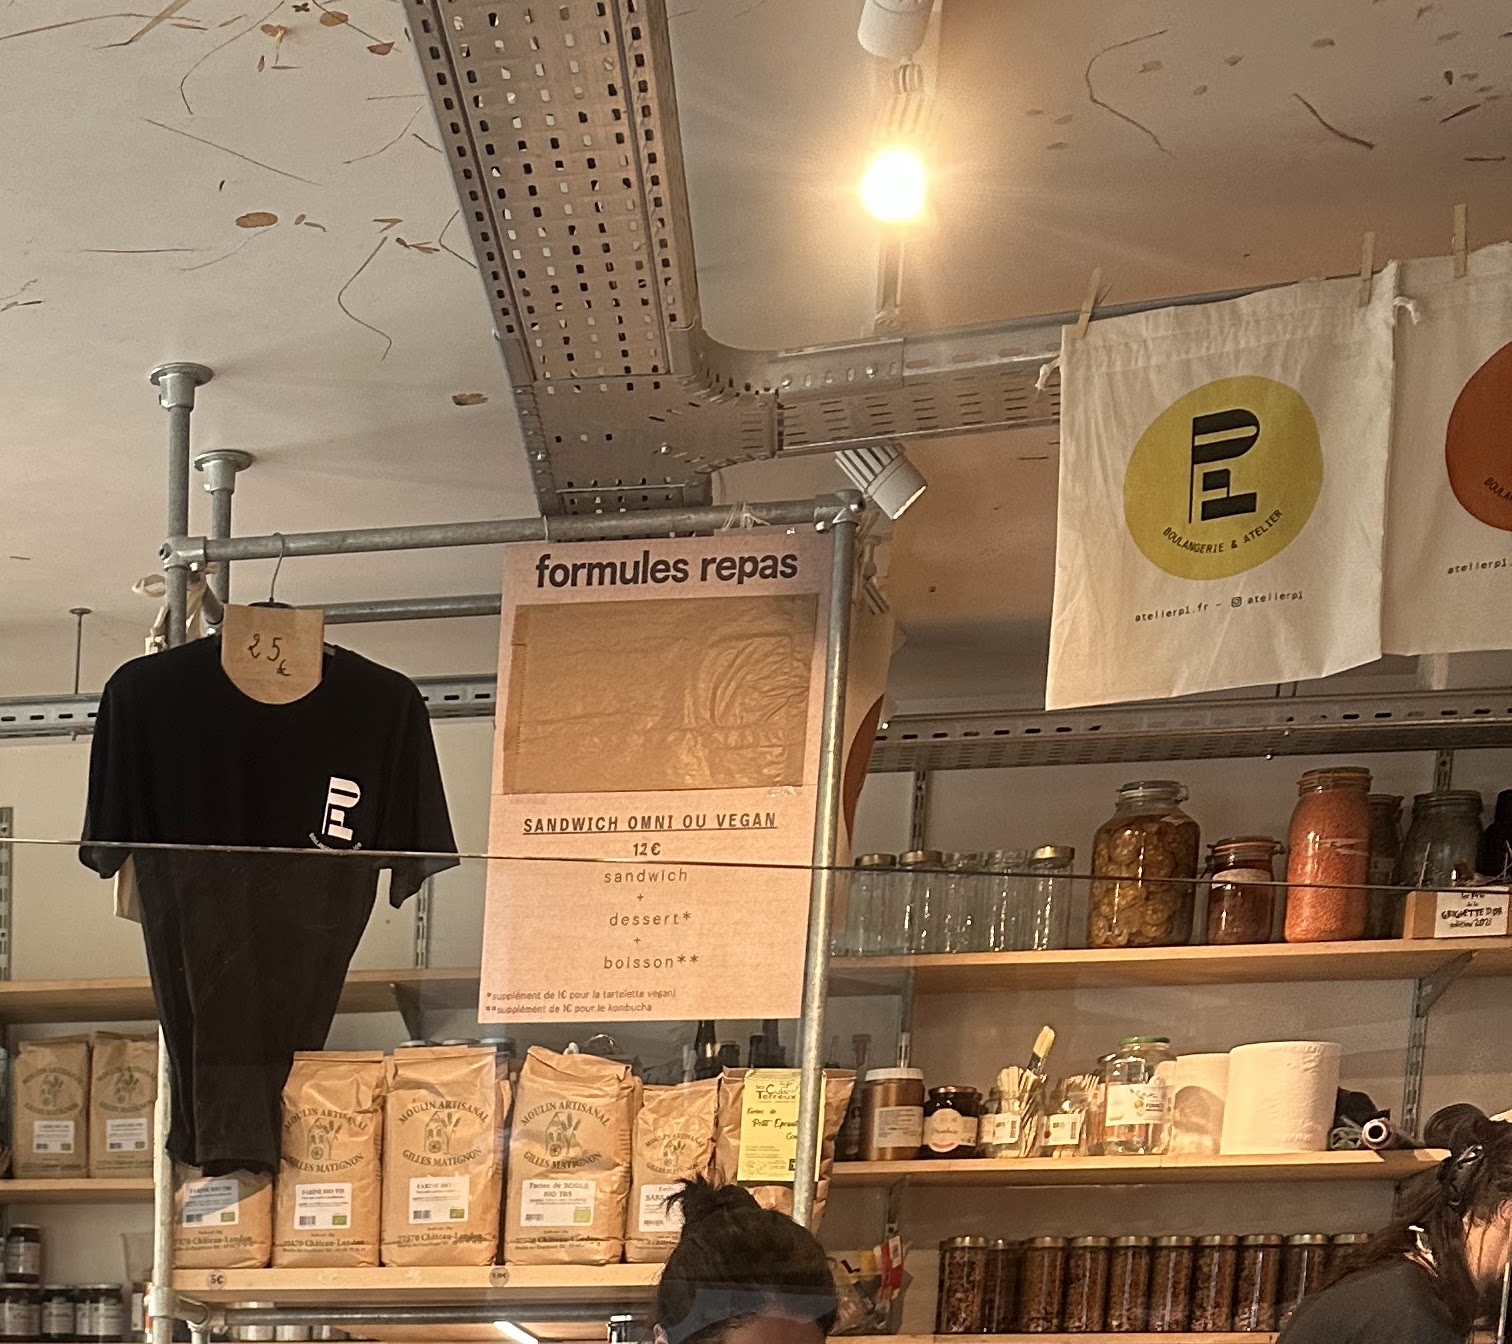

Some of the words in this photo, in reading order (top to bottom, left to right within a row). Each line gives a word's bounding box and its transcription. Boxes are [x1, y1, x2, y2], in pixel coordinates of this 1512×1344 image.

[1162, 526, 1224, 554] BOULANGERIE
[1243, 509, 1283, 544] ATELIER
[535, 550, 689, 588] formules
[700, 553, 798, 585] repas
[523, 816, 618, 833] SANDWICH
[628, 815, 673, 830] OMNI
[682, 813, 707, 829] OU
[716, 812, 777, 829] VEGAN
[632, 842, 662, 856] 12€
[603, 868, 688, 884] sandwich
[398, 1100, 436, 1125] MOULIN
[438, 1099, 489, 1123] ARTISANAL
[520, 1102, 556, 1126] MOULIN
[558, 1100, 611, 1127] ARTISANAL
[317, 1151, 365, 1173] MATIGNON
[402, 1149, 432, 1167] GILLES
[434, 1147, 482, 1167] MATIGNON
[523, 1151, 550, 1168] GILLES
